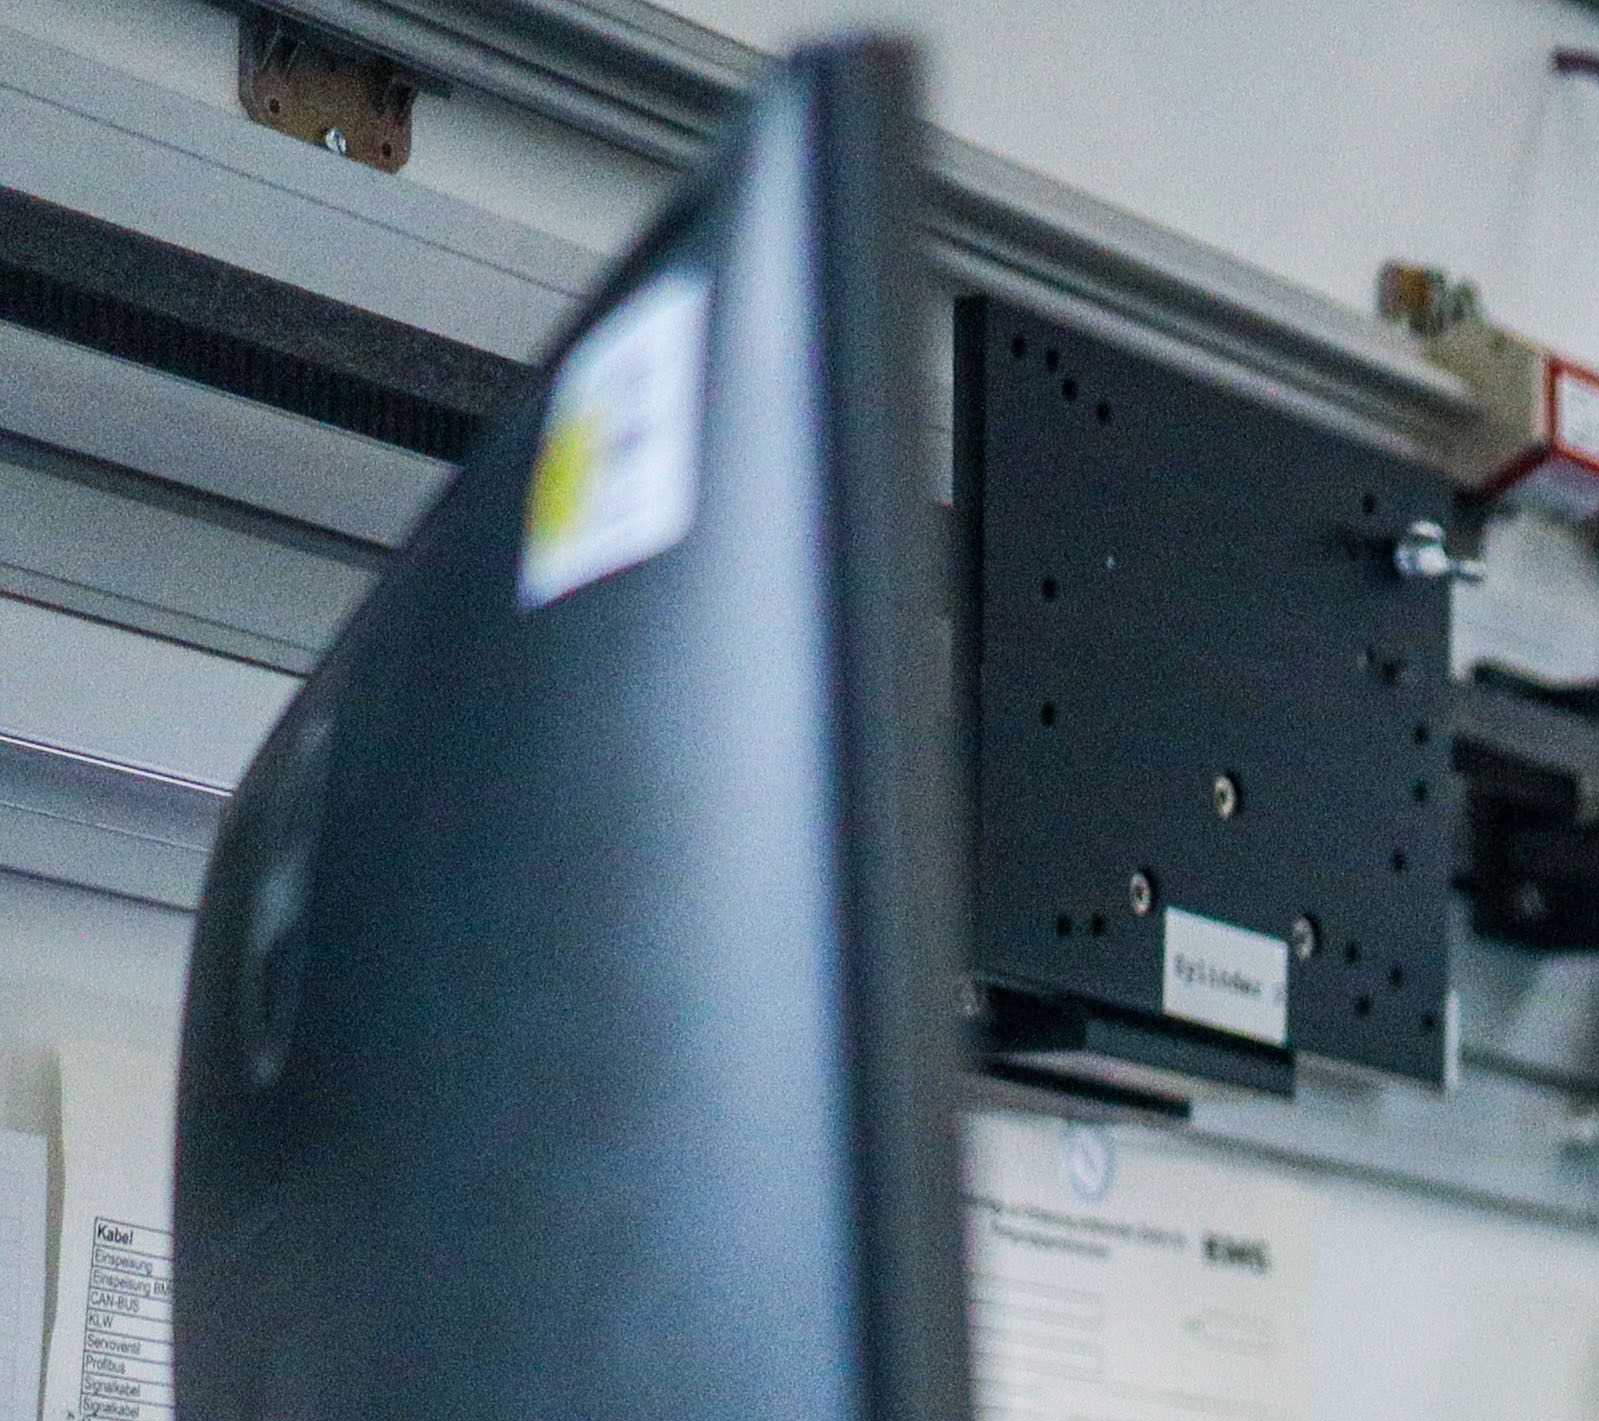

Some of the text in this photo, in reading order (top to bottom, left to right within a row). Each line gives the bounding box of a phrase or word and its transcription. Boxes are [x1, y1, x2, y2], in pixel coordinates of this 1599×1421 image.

[97, 1224, 134, 1246] Kabel
[94, 1249, 154, 1276] Einspeisung
[93, 1269, 151, 1298] Einspeisung
[90, 1290, 140, 1314] CAN-BUS
[88, 1309, 114, 1329] KLW
[86, 1332, 142, 1355] Servoventil
[84, 1354, 126, 1375] Profibus
[83, 1376, 141, 1398] Signalkabel
[82, 1397, 140, 1418] Signalkabel
